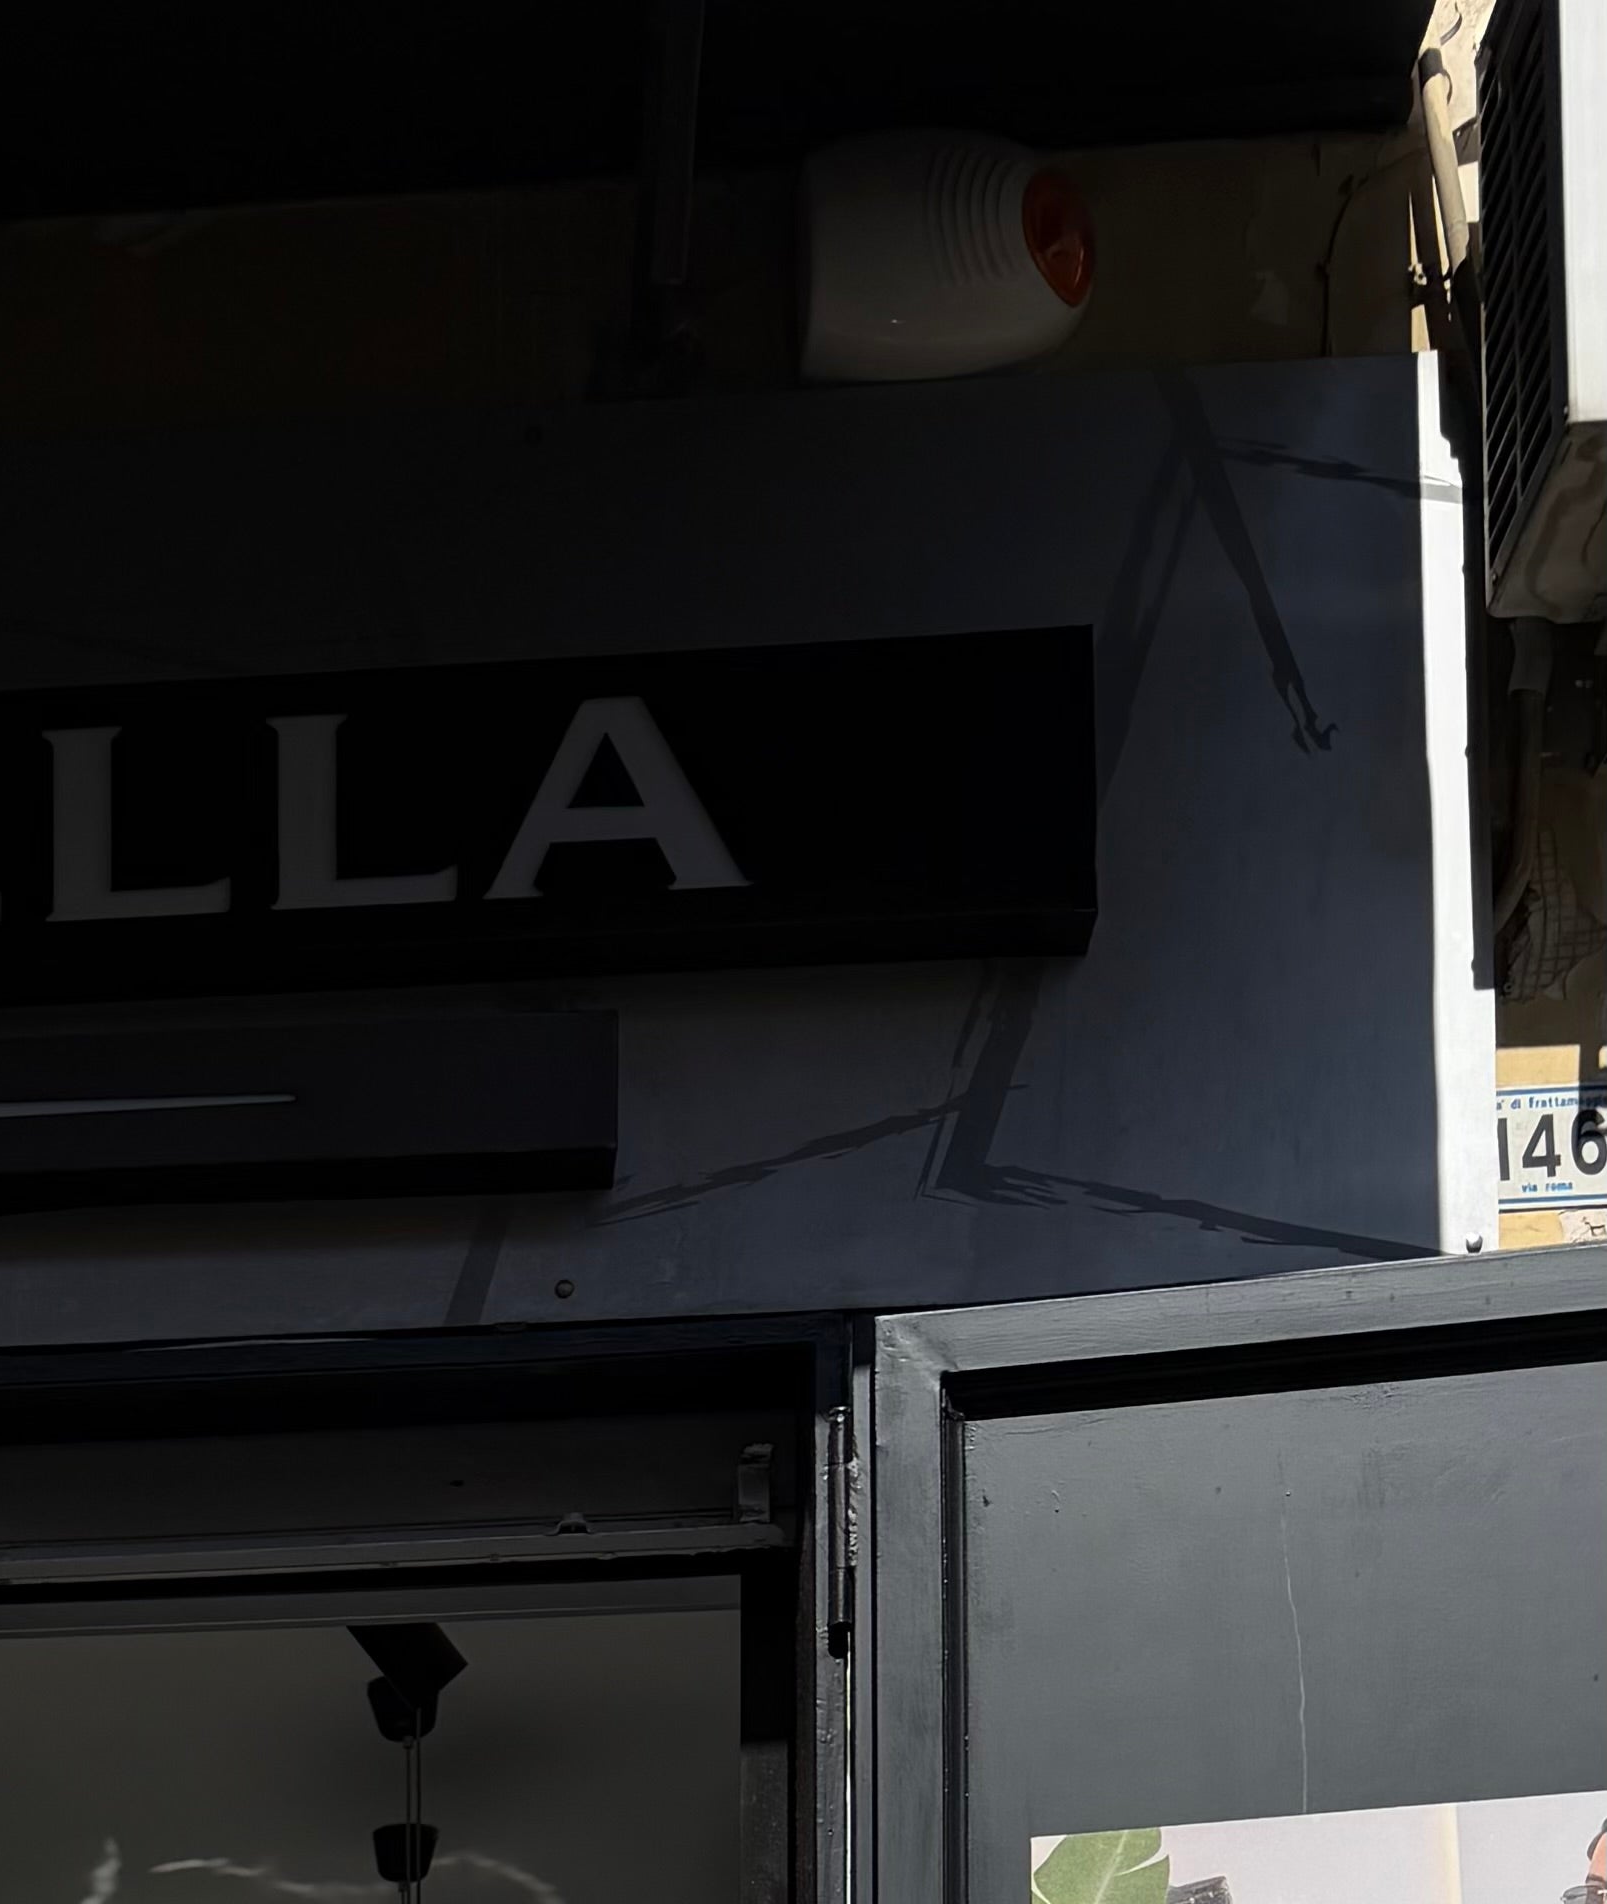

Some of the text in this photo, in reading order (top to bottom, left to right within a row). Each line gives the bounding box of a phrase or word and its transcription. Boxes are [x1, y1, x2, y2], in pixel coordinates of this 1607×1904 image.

[1497, 1109, 1607, 1181] 146
[1521, 1182, 1573, 1193] via roma
